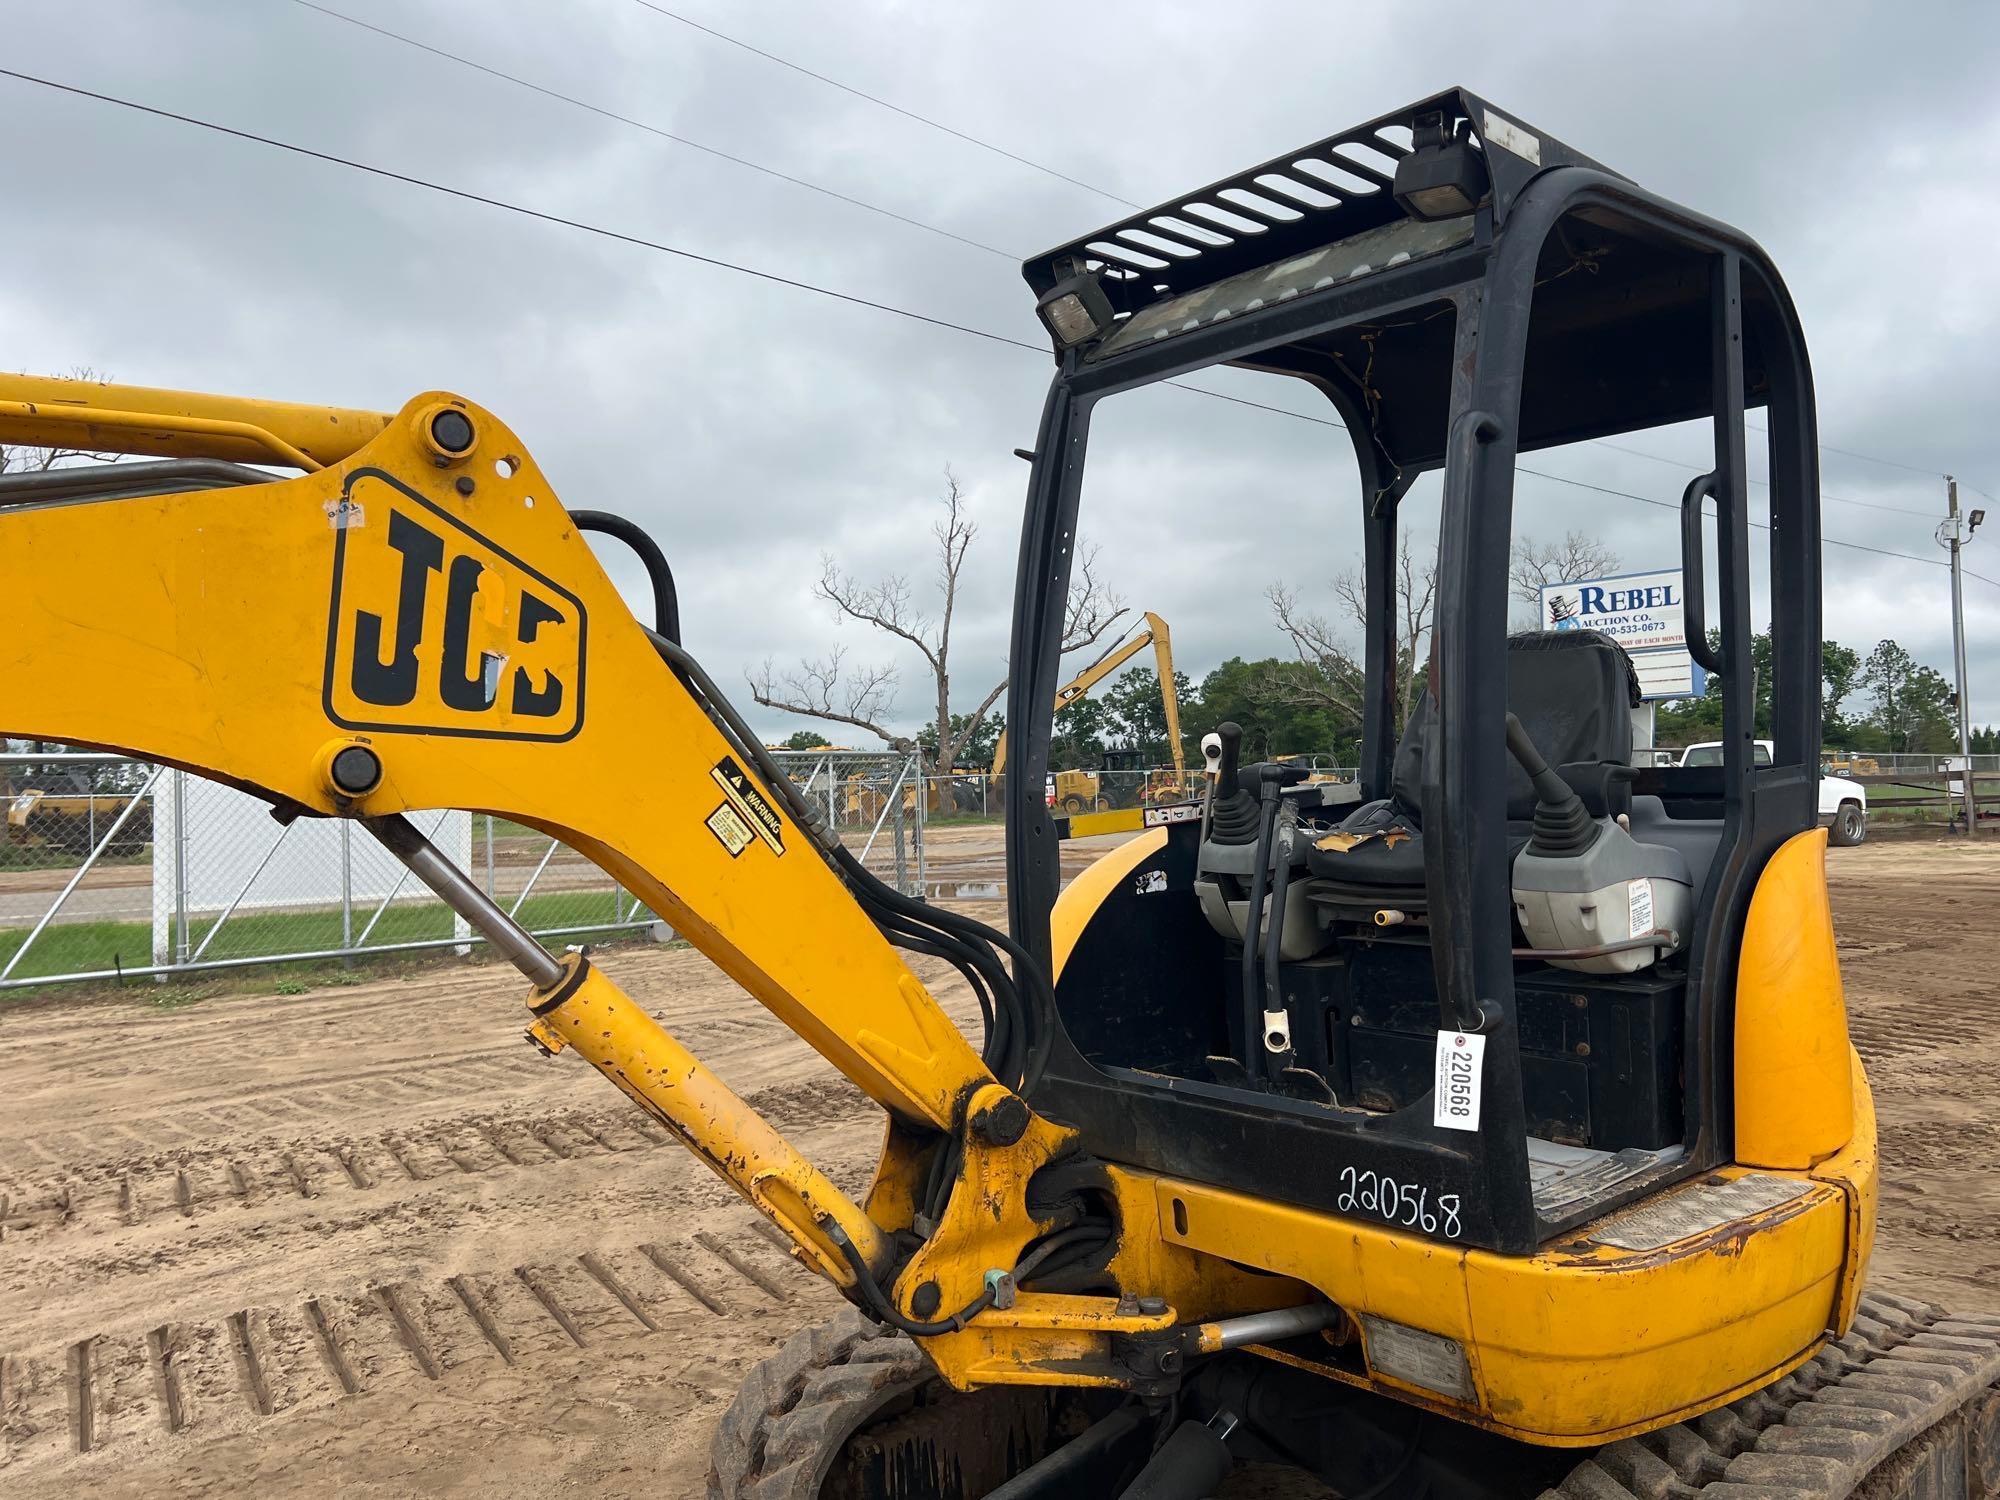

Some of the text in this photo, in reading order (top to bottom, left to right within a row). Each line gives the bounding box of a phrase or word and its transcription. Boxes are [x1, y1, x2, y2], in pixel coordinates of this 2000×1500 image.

[352, 508, 565, 717] JCB
[1579, 586, 1680, 615] REBEL
[1582, 614, 1651, 627] AUCTION CO.
[746, 790, 781, 834] WARNING
[1450, 1051, 1473, 1117] 220568
[1338, 1166, 1461, 1238] 220568
